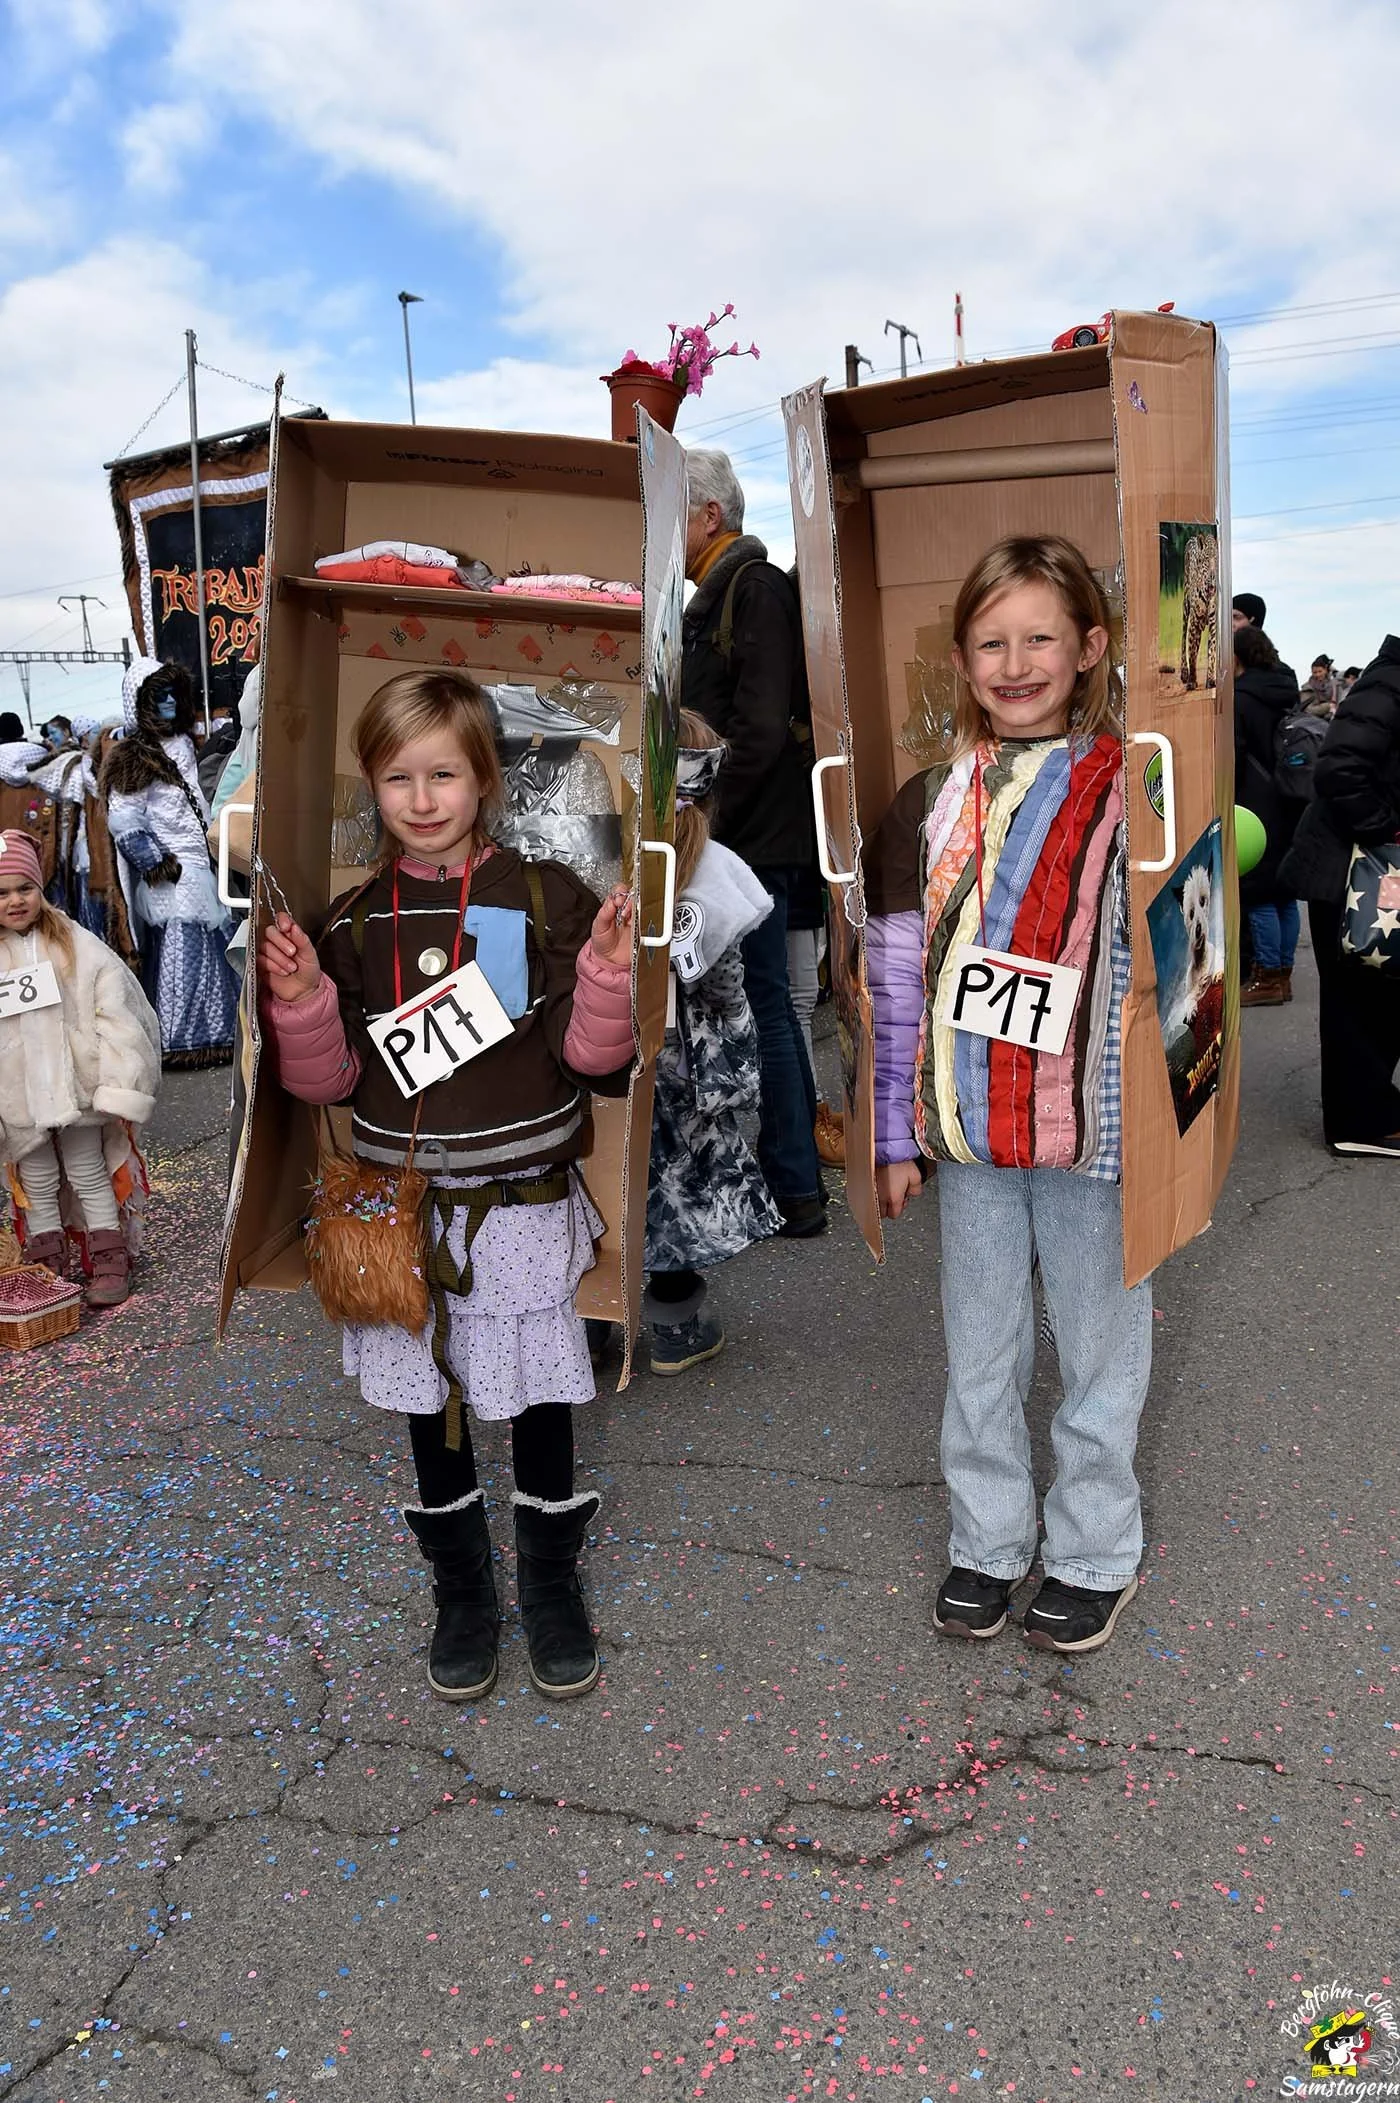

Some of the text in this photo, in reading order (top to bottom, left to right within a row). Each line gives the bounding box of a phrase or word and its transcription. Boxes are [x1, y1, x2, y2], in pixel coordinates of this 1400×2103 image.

[152, 554, 265, 624] TRIBAD
[383, 993, 484, 1092] P17
[952, 963, 1052, 1044] P17
